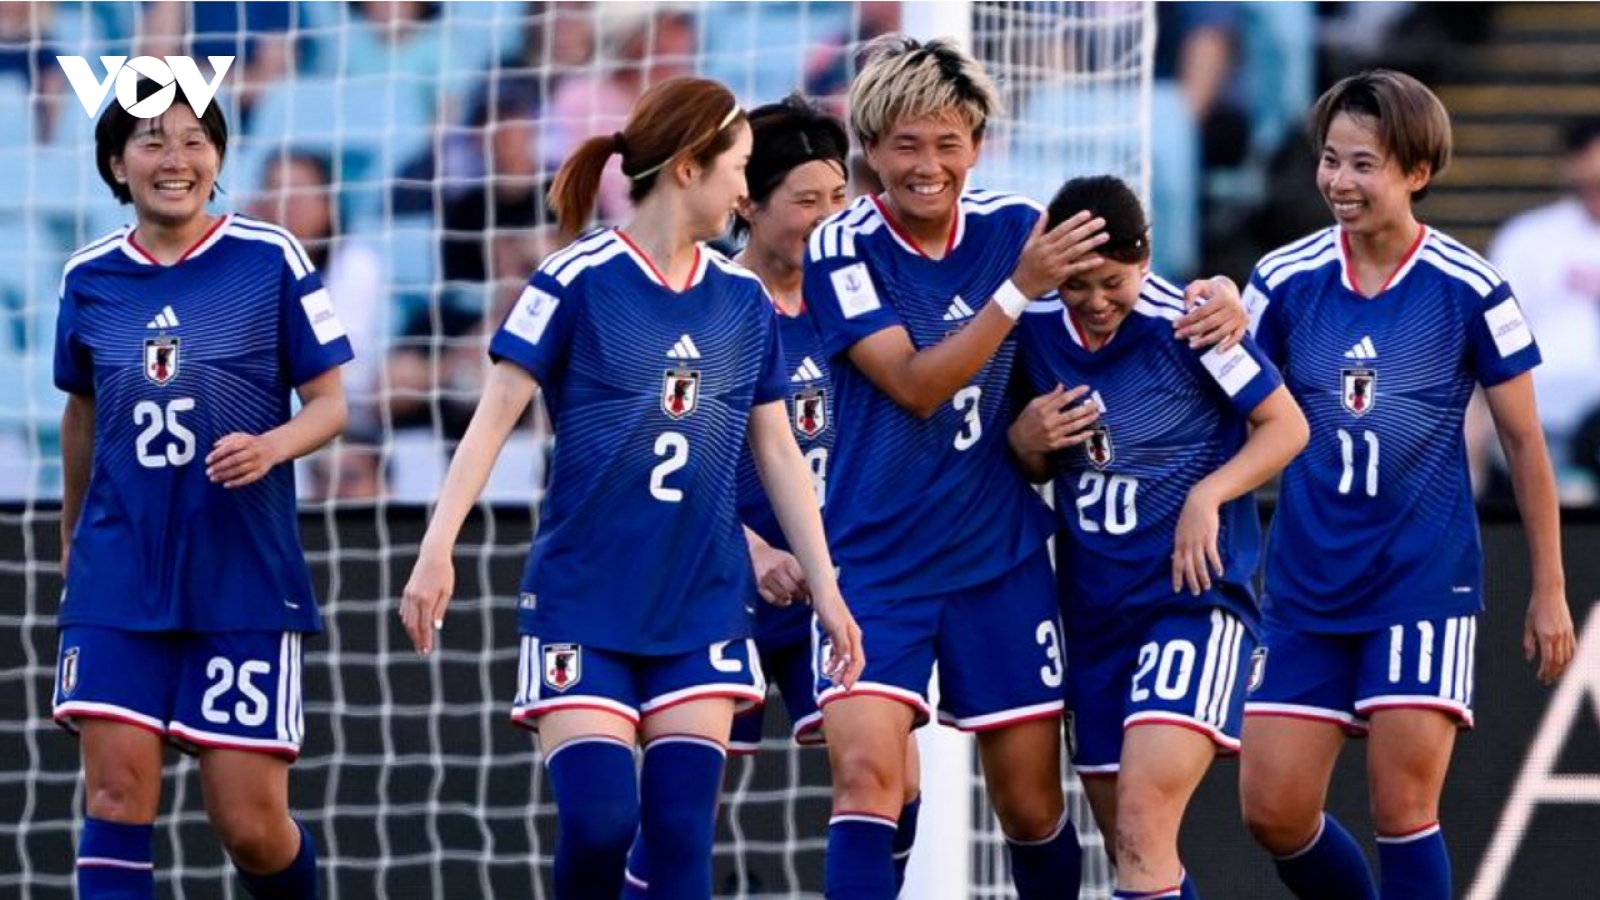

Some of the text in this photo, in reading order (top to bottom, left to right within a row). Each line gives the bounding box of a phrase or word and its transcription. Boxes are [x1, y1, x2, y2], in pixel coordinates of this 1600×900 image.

[134, 398, 195, 467] 25
[953, 385, 982, 451] 3
[649, 431, 689, 502] 2
[1338, 429, 1379, 496] 11
[1077, 476, 1138, 534] 20
[1036, 620, 1062, 687] 3
[1131, 639, 1195, 702] 20
[1389, 620, 1434, 684] 11
[202, 657, 270, 726] 25
